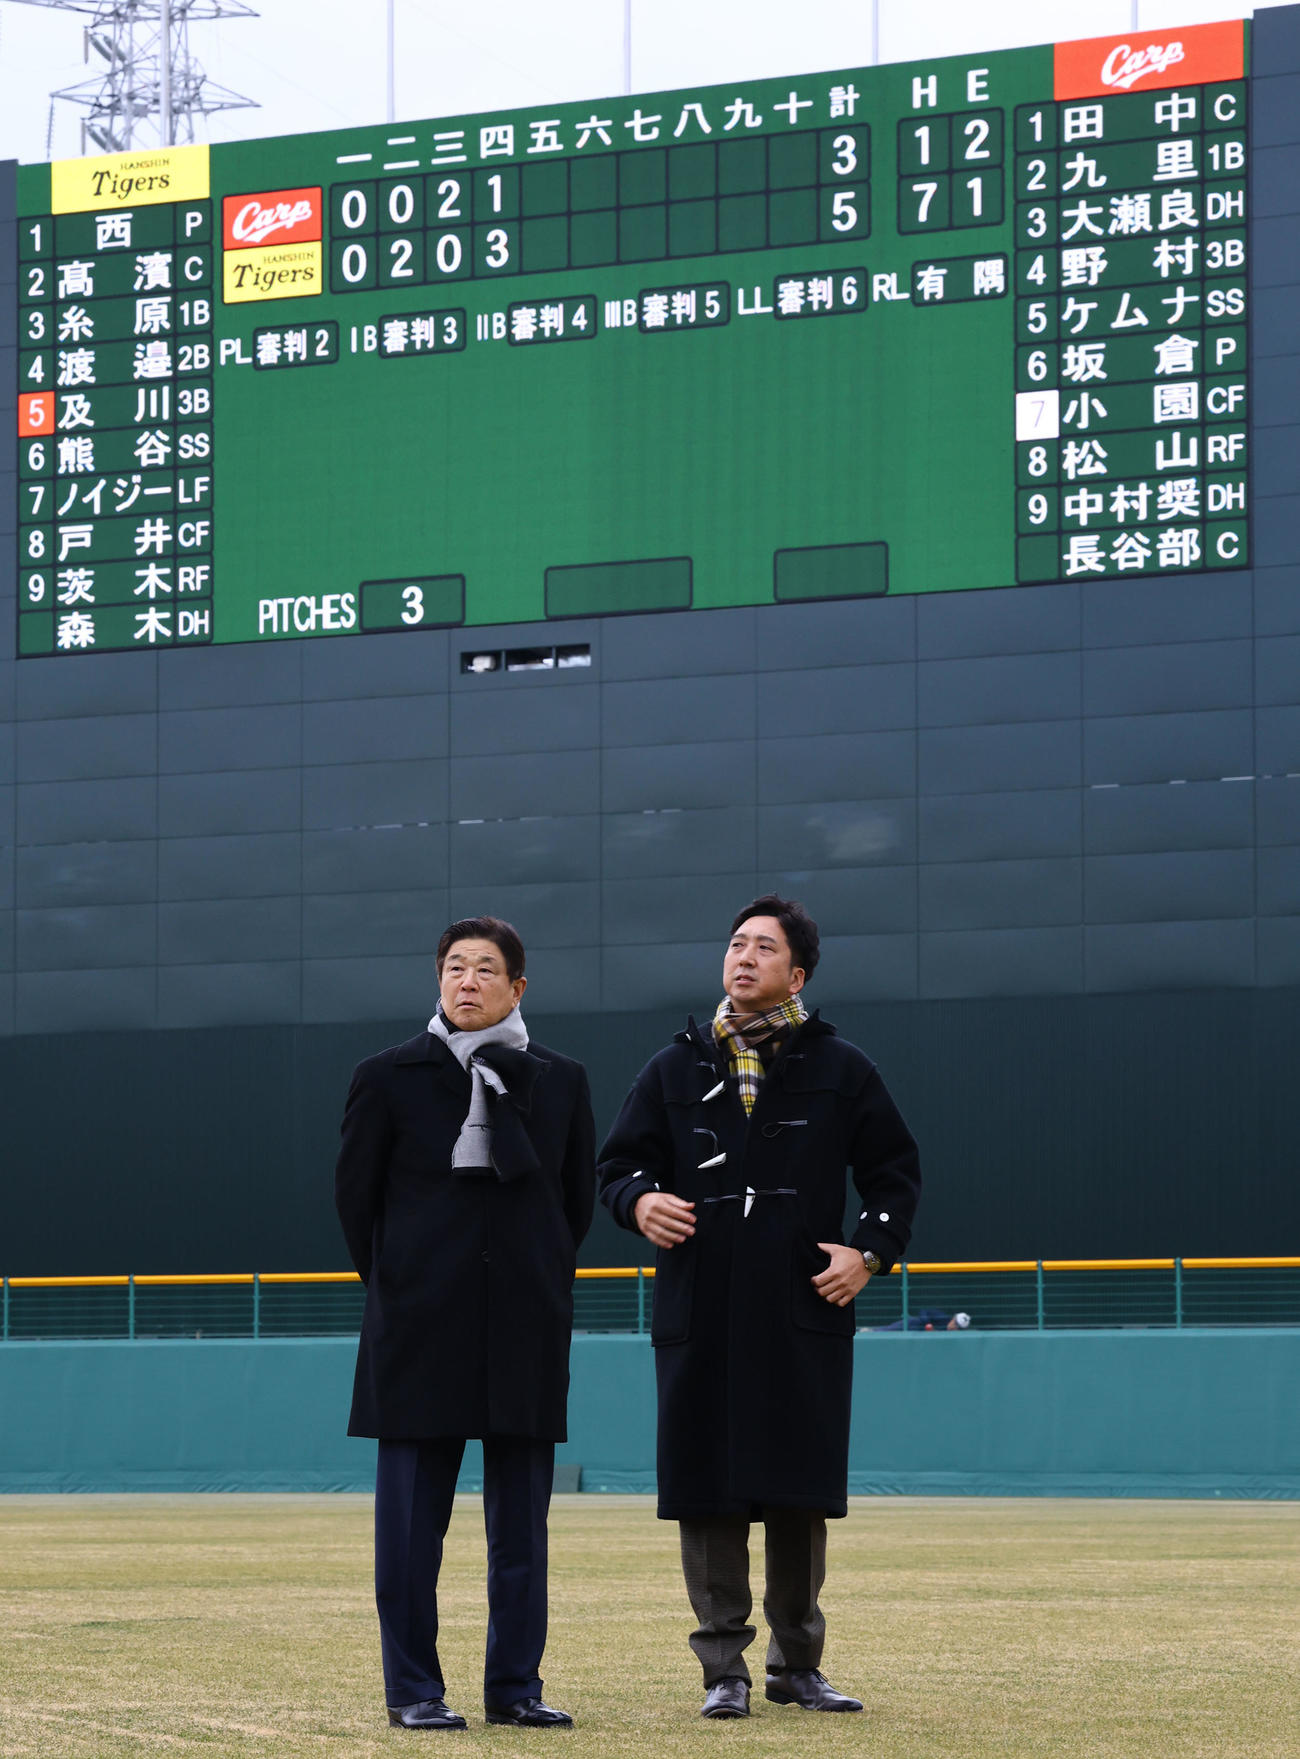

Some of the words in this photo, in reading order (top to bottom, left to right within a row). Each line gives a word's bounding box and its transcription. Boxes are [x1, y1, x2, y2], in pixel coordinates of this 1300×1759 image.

[1101, 42, 1185, 89] Carp
[337, 154, 372, 164] 一
[383, 137, 419, 170] 二
[431, 131, 466, 164] 三
[480, 125, 513, 158] 四
[527, 120, 563, 153] 五
[576, 116, 612, 148] 六
[624, 110, 661, 141] 七
[674, 104, 711, 137] 八
[724, 98, 762, 130] 九
[774, 92, 813, 124] 十
[829, 85, 860, 118] 計
[913, 75, 936, 108] H
[968, 69, 989, 102] E
[1028, 112, 1042, 142] 1
[1215, 94, 1236, 121] C
[92, 170, 170, 200] Tigers
[232, 200, 312, 243] Carp
[342, 191, 366, 228] 0
[389, 185, 413, 223] 0
[438, 180, 460, 218] 2
[488, 175, 501, 212] 1
[832, 135, 856, 174] 3
[915, 126, 929, 164] 1
[965, 120, 989, 159] 2
[1027, 160, 1046, 190] 2
[1208, 142, 1244, 171] 1B
[29, 224, 41, 251] 1
[96, 213, 133, 249] 西
[186, 212, 202, 236] P
[234, 260, 314, 291] Tigers
[343, 245, 366, 282] 0
[391, 240, 413, 277] 2
[437, 235, 461, 272] 0
[486, 229, 508, 267] 3
[832, 192, 857, 231] 5
[913, 183, 937, 222] 7
[967, 178, 981, 216] 1
[1028, 208, 1046, 237] 3
[1207, 191, 1243, 220] DH
[29, 268, 44, 296] 2
[185, 256, 202, 280] C
[1027, 255, 1046, 285] 4
[1207, 240, 1244, 268] 3B
[29, 312, 44, 339] 3
[180, 300, 210, 326] 1B
[220, 338, 252, 366] PL
[738, 286, 774, 315] LL
[873, 272, 910, 302] RL
[1028, 303, 1047, 334] 5
[1207, 289, 1244, 316] SS
[28, 356, 44, 383] 4
[178, 344, 210, 370] 2B
[1028, 351, 1047, 381] 6
[1217, 338, 1236, 365] P
[29, 399, 45, 427] 5
[179, 389, 210, 414] 3B
[1030, 400, 1045, 428] 7
[1207, 385, 1245, 413] CF
[29, 443, 44, 470] 6
[179, 433, 209, 458] SS
[1028, 447, 1047, 476] 8
[1208, 434, 1245, 463] RF
[29, 487, 44, 514] 7
[58, 475, 172, 516] ノイジー
[179, 477, 209, 503] LF
[1029, 494, 1047, 524] 9
[1064, 479, 1200, 526] 中村奨
[1208, 483, 1244, 511] DH
[29, 531, 44, 558] 8
[178, 521, 209, 547] CF
[1063, 528, 1200, 576] 長谷部
[1217, 532, 1238, 558] C
[29, 574, 44, 601] 9
[179, 566, 209, 592] RF
[179, 610, 209, 637] DH
[259, 592, 356, 634] PITCHES
[402, 585, 424, 625] 3
